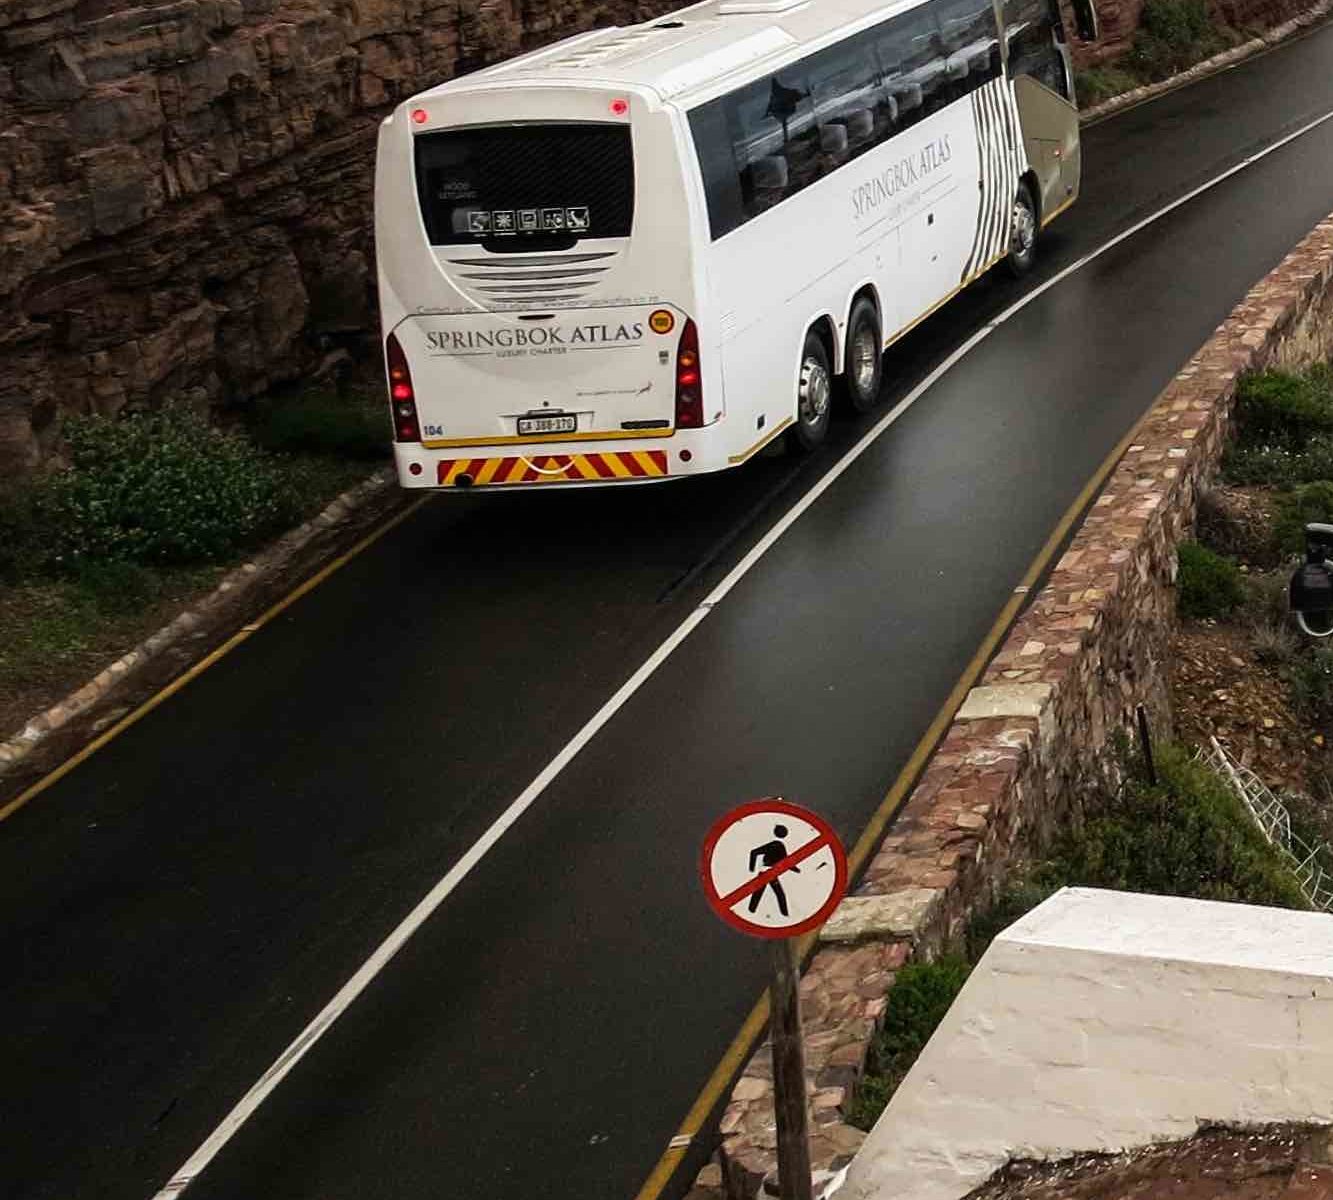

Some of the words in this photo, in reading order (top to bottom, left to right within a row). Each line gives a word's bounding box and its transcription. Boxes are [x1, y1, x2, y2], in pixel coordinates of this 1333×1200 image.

[852, 155, 919, 220] SPRINGBOK
[919, 133, 952, 179] ATLAS
[427, 327, 565, 349] SPRINGBOK
[571, 322, 643, 344] ATLAS
[423, 425, 443, 436] 104
